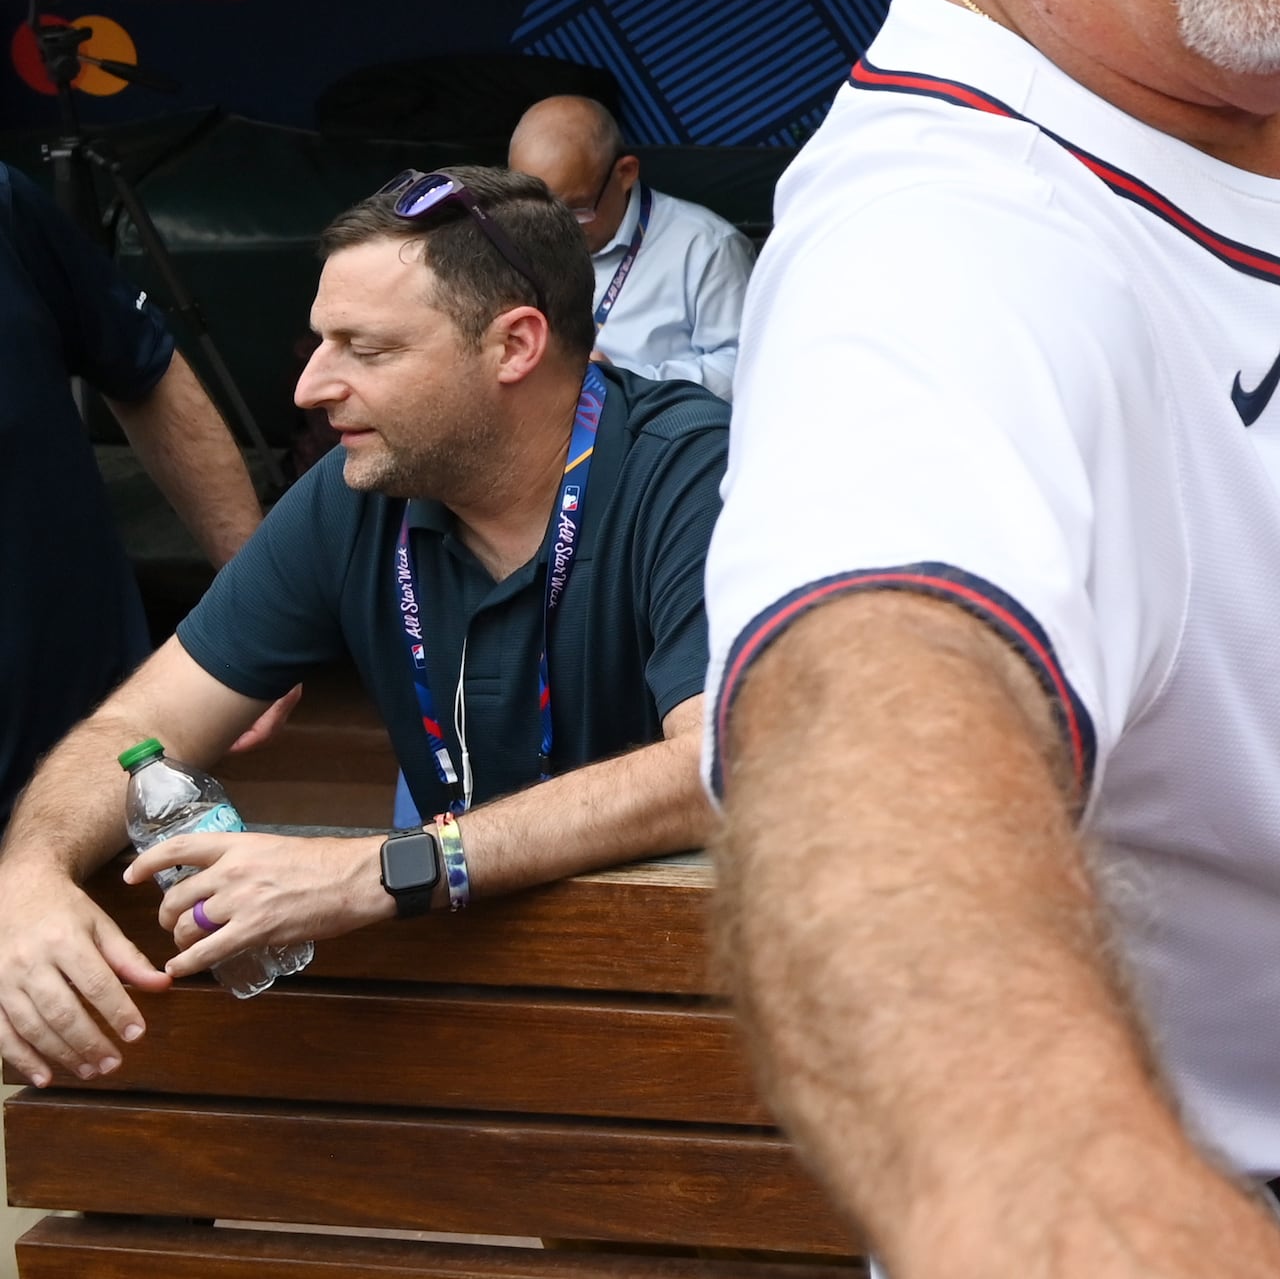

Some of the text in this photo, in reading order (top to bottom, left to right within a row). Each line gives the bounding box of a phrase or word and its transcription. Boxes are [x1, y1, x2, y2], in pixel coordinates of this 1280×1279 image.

[397, 547, 423, 640] All Star Week
[548, 511, 576, 609] All Star Week
